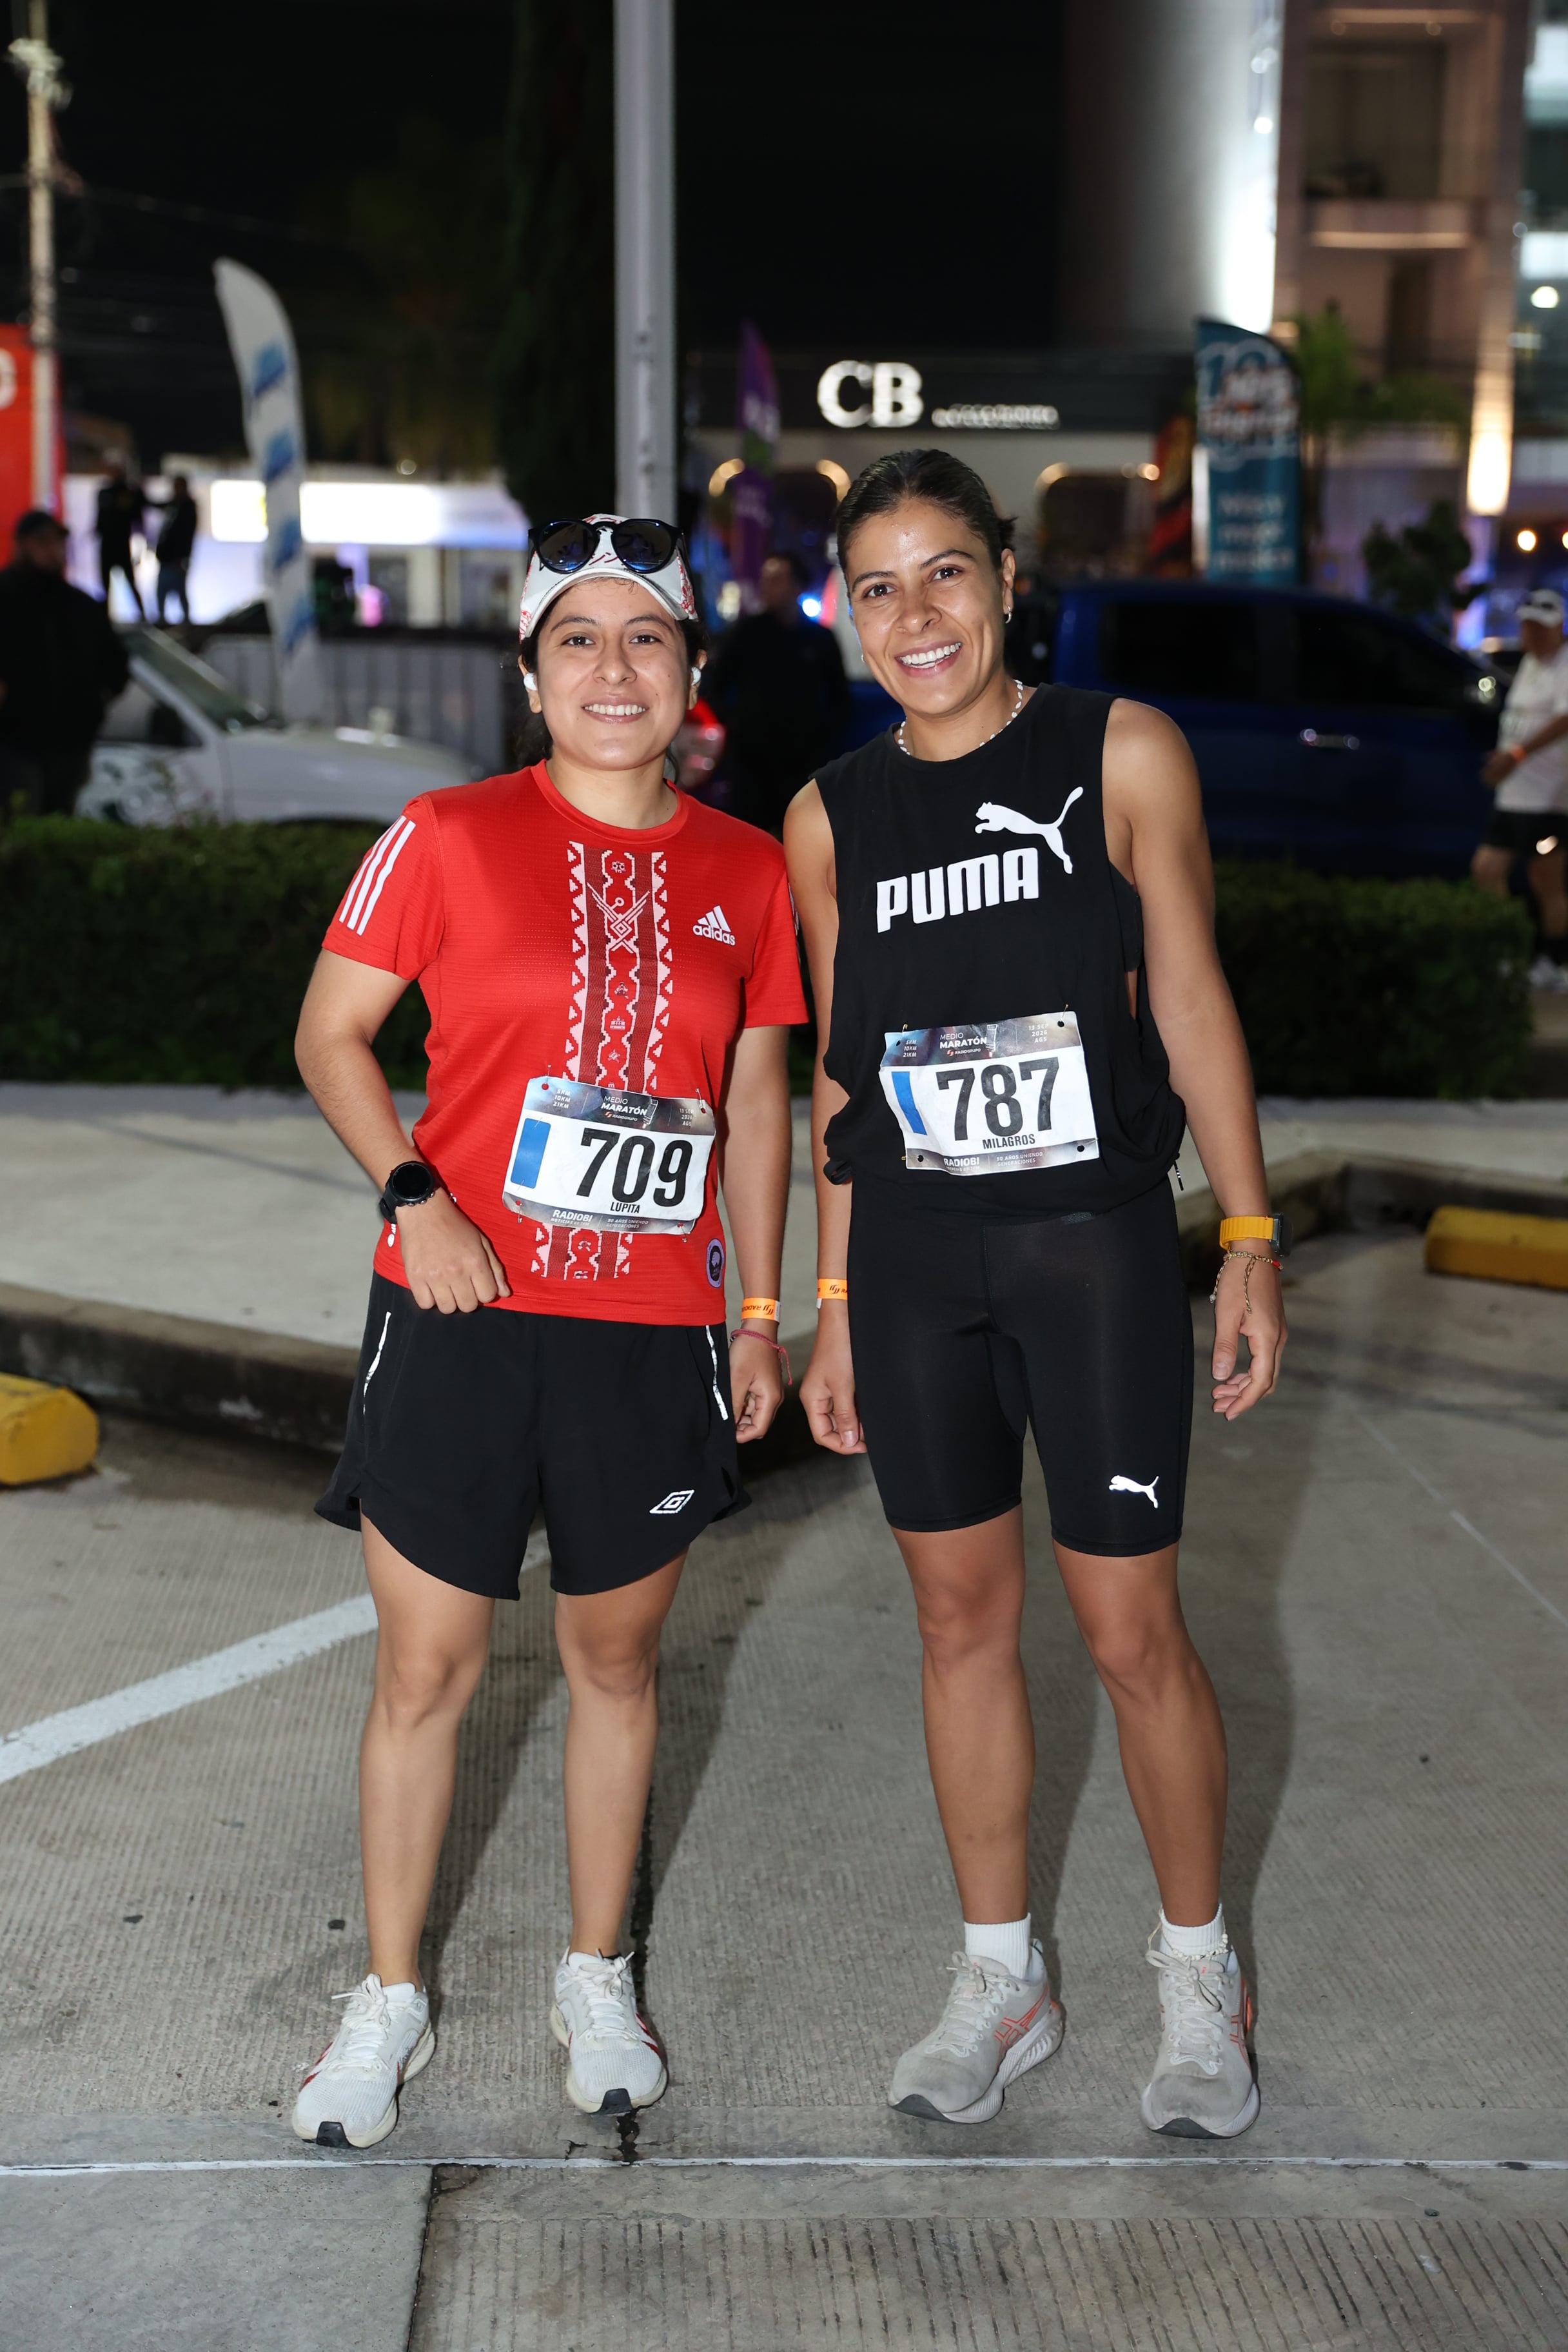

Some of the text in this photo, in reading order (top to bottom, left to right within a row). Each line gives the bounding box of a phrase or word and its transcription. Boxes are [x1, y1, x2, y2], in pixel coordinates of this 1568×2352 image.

[817, 360, 924, 428] CB
[876, 847, 1039, 933] PUMA
[692, 925, 736, 946] adidas
[939, 1036, 987, 1049] MARATÓN
[603, 1096, 628, 1104] MEDIO
[936, 1056, 1059, 1141] 787
[601, 1102, 648, 1115] MARATÓN
[983, 1133, 1035, 1150] MILAGROS
[576, 1128, 693, 1207] 709
[943, 1157, 980, 1167] RADIOBI
[610, 1202, 641, 1213] LUPITA
[553, 1210, 593, 1222] RADIOBI
